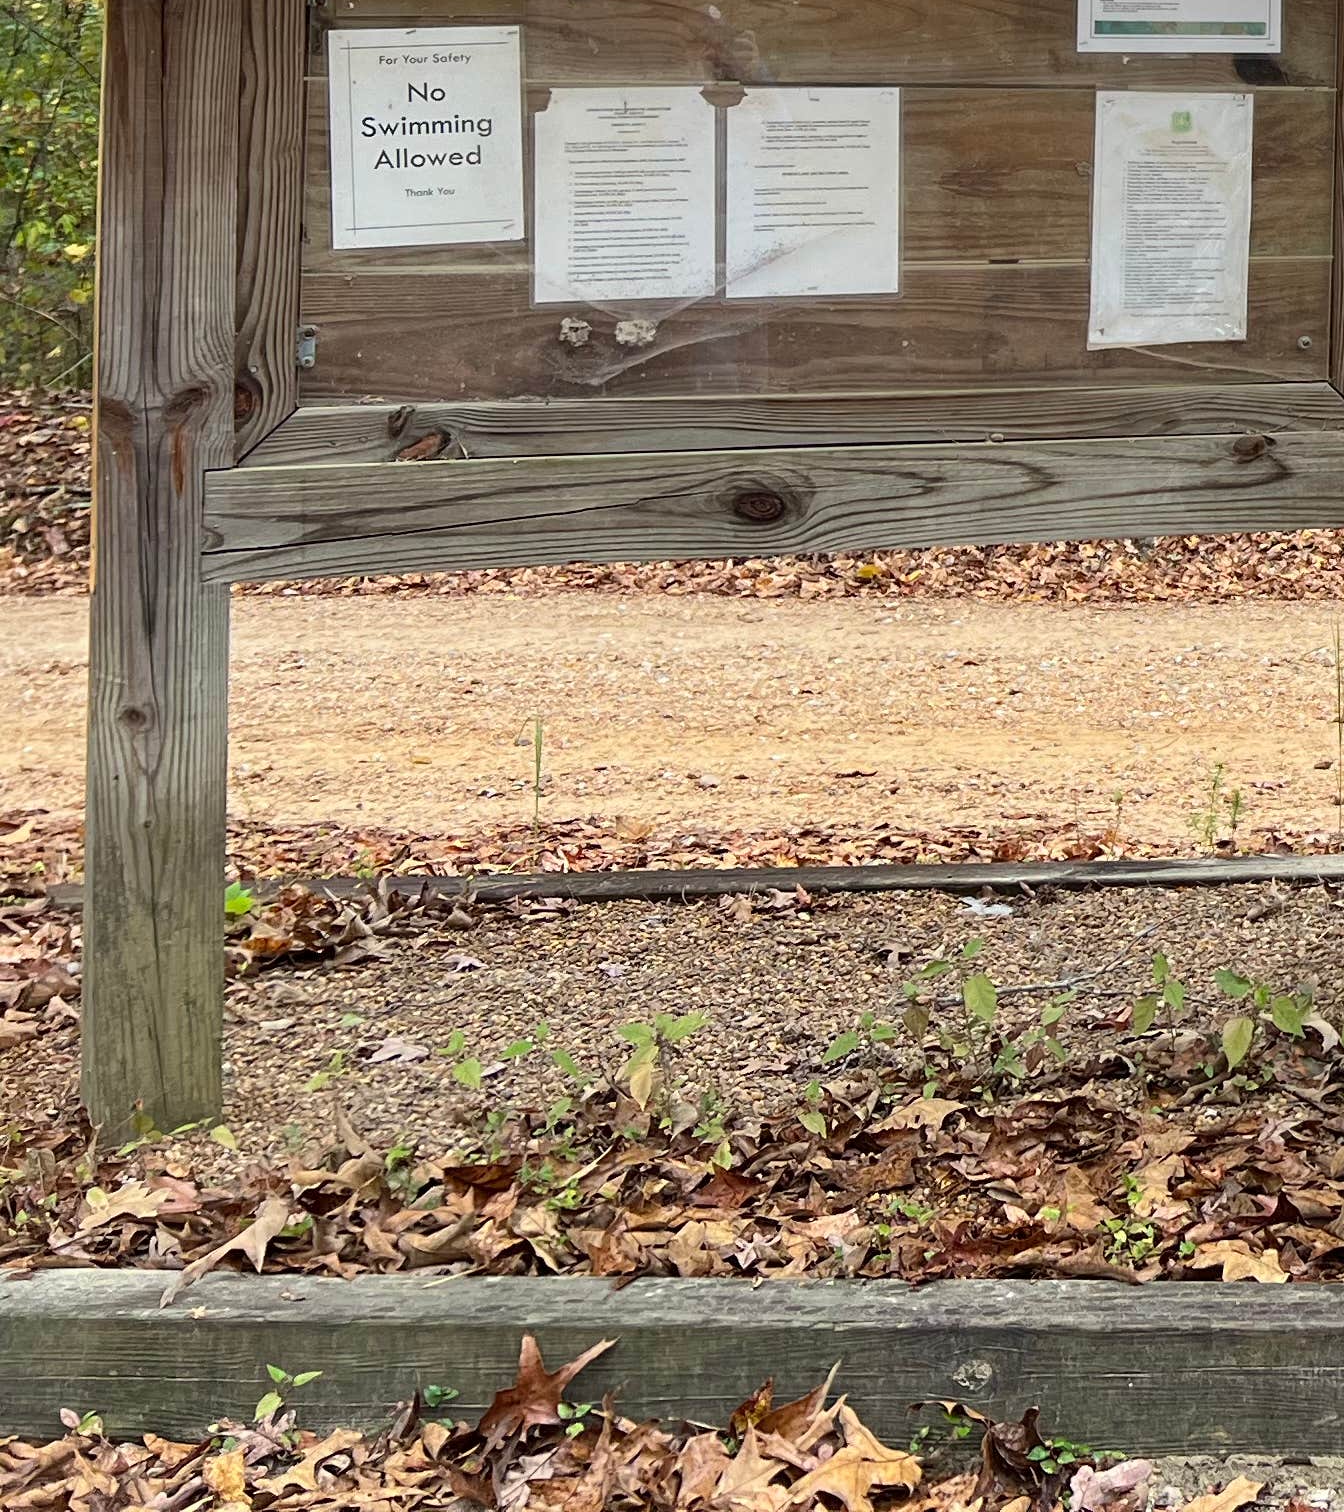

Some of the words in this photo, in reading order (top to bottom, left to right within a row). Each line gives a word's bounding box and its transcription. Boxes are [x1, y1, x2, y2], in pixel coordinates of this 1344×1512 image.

[378, 55, 398, 65] For
[401, 54, 428, 64] Your
[432, 52, 472, 65] Safety
[408, 82, 446, 102] No
[361, 114, 493, 138] Swimming
[374, 145, 481, 170] Allowed
[405, 188, 434, 197] Thank
[437, 187, 456, 196] You
